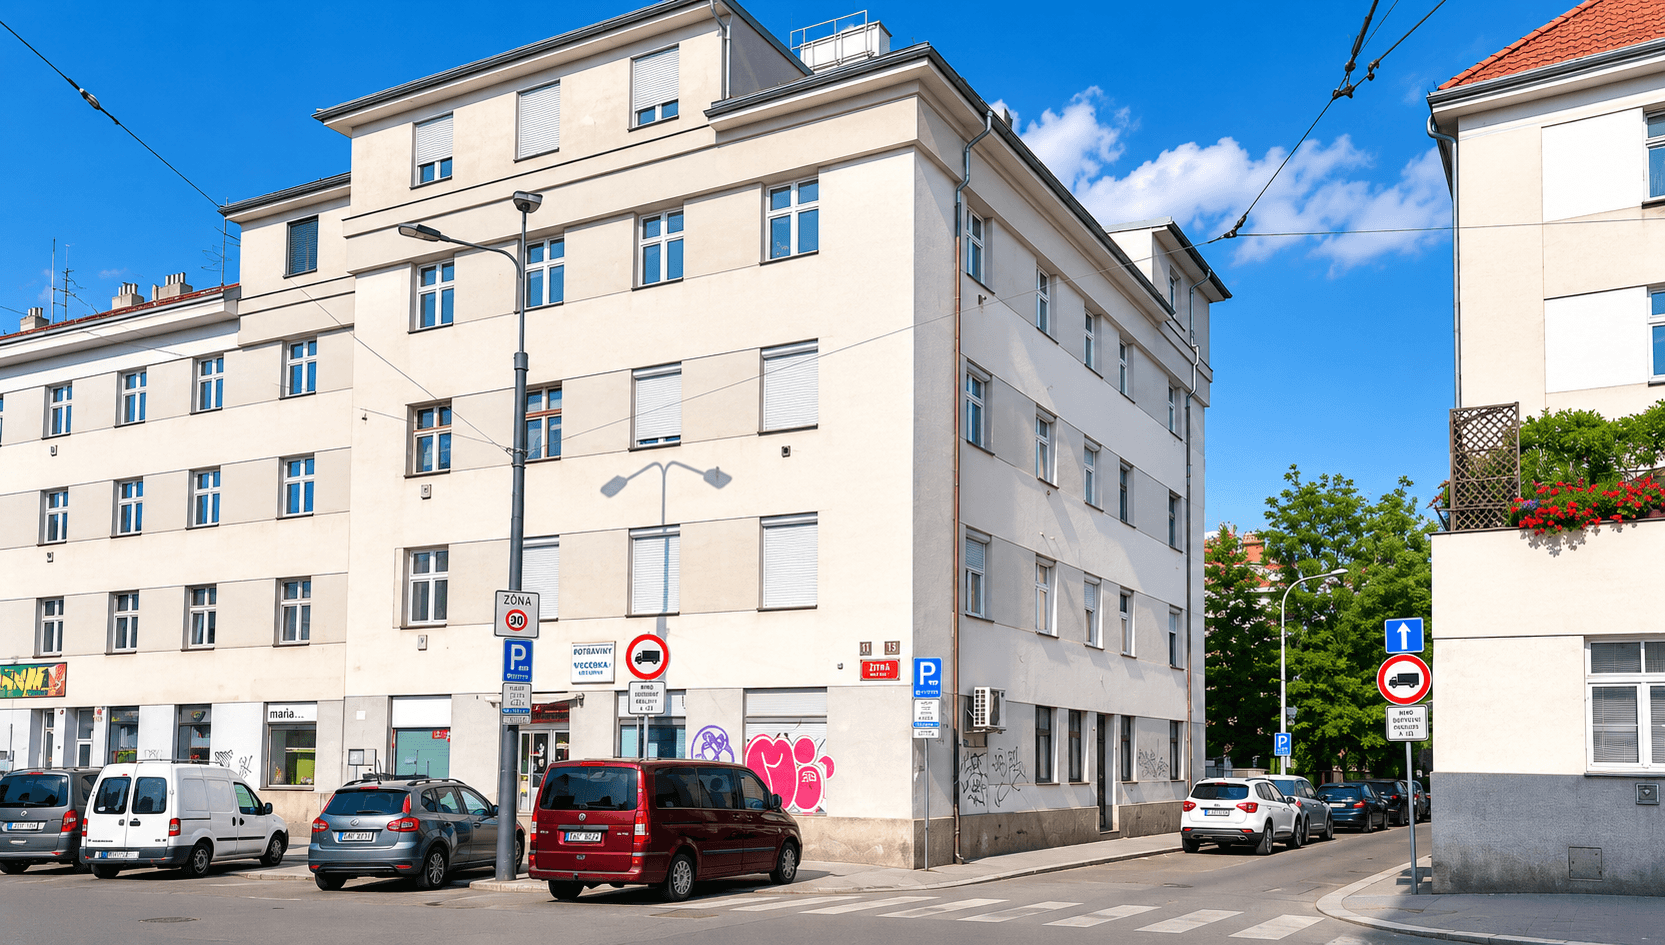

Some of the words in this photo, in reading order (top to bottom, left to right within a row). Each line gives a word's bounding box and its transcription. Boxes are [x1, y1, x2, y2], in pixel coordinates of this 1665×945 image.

[510, 644, 527, 671] P
[919, 661, 937, 686] P
[1278, 735, 1288, 748] P
